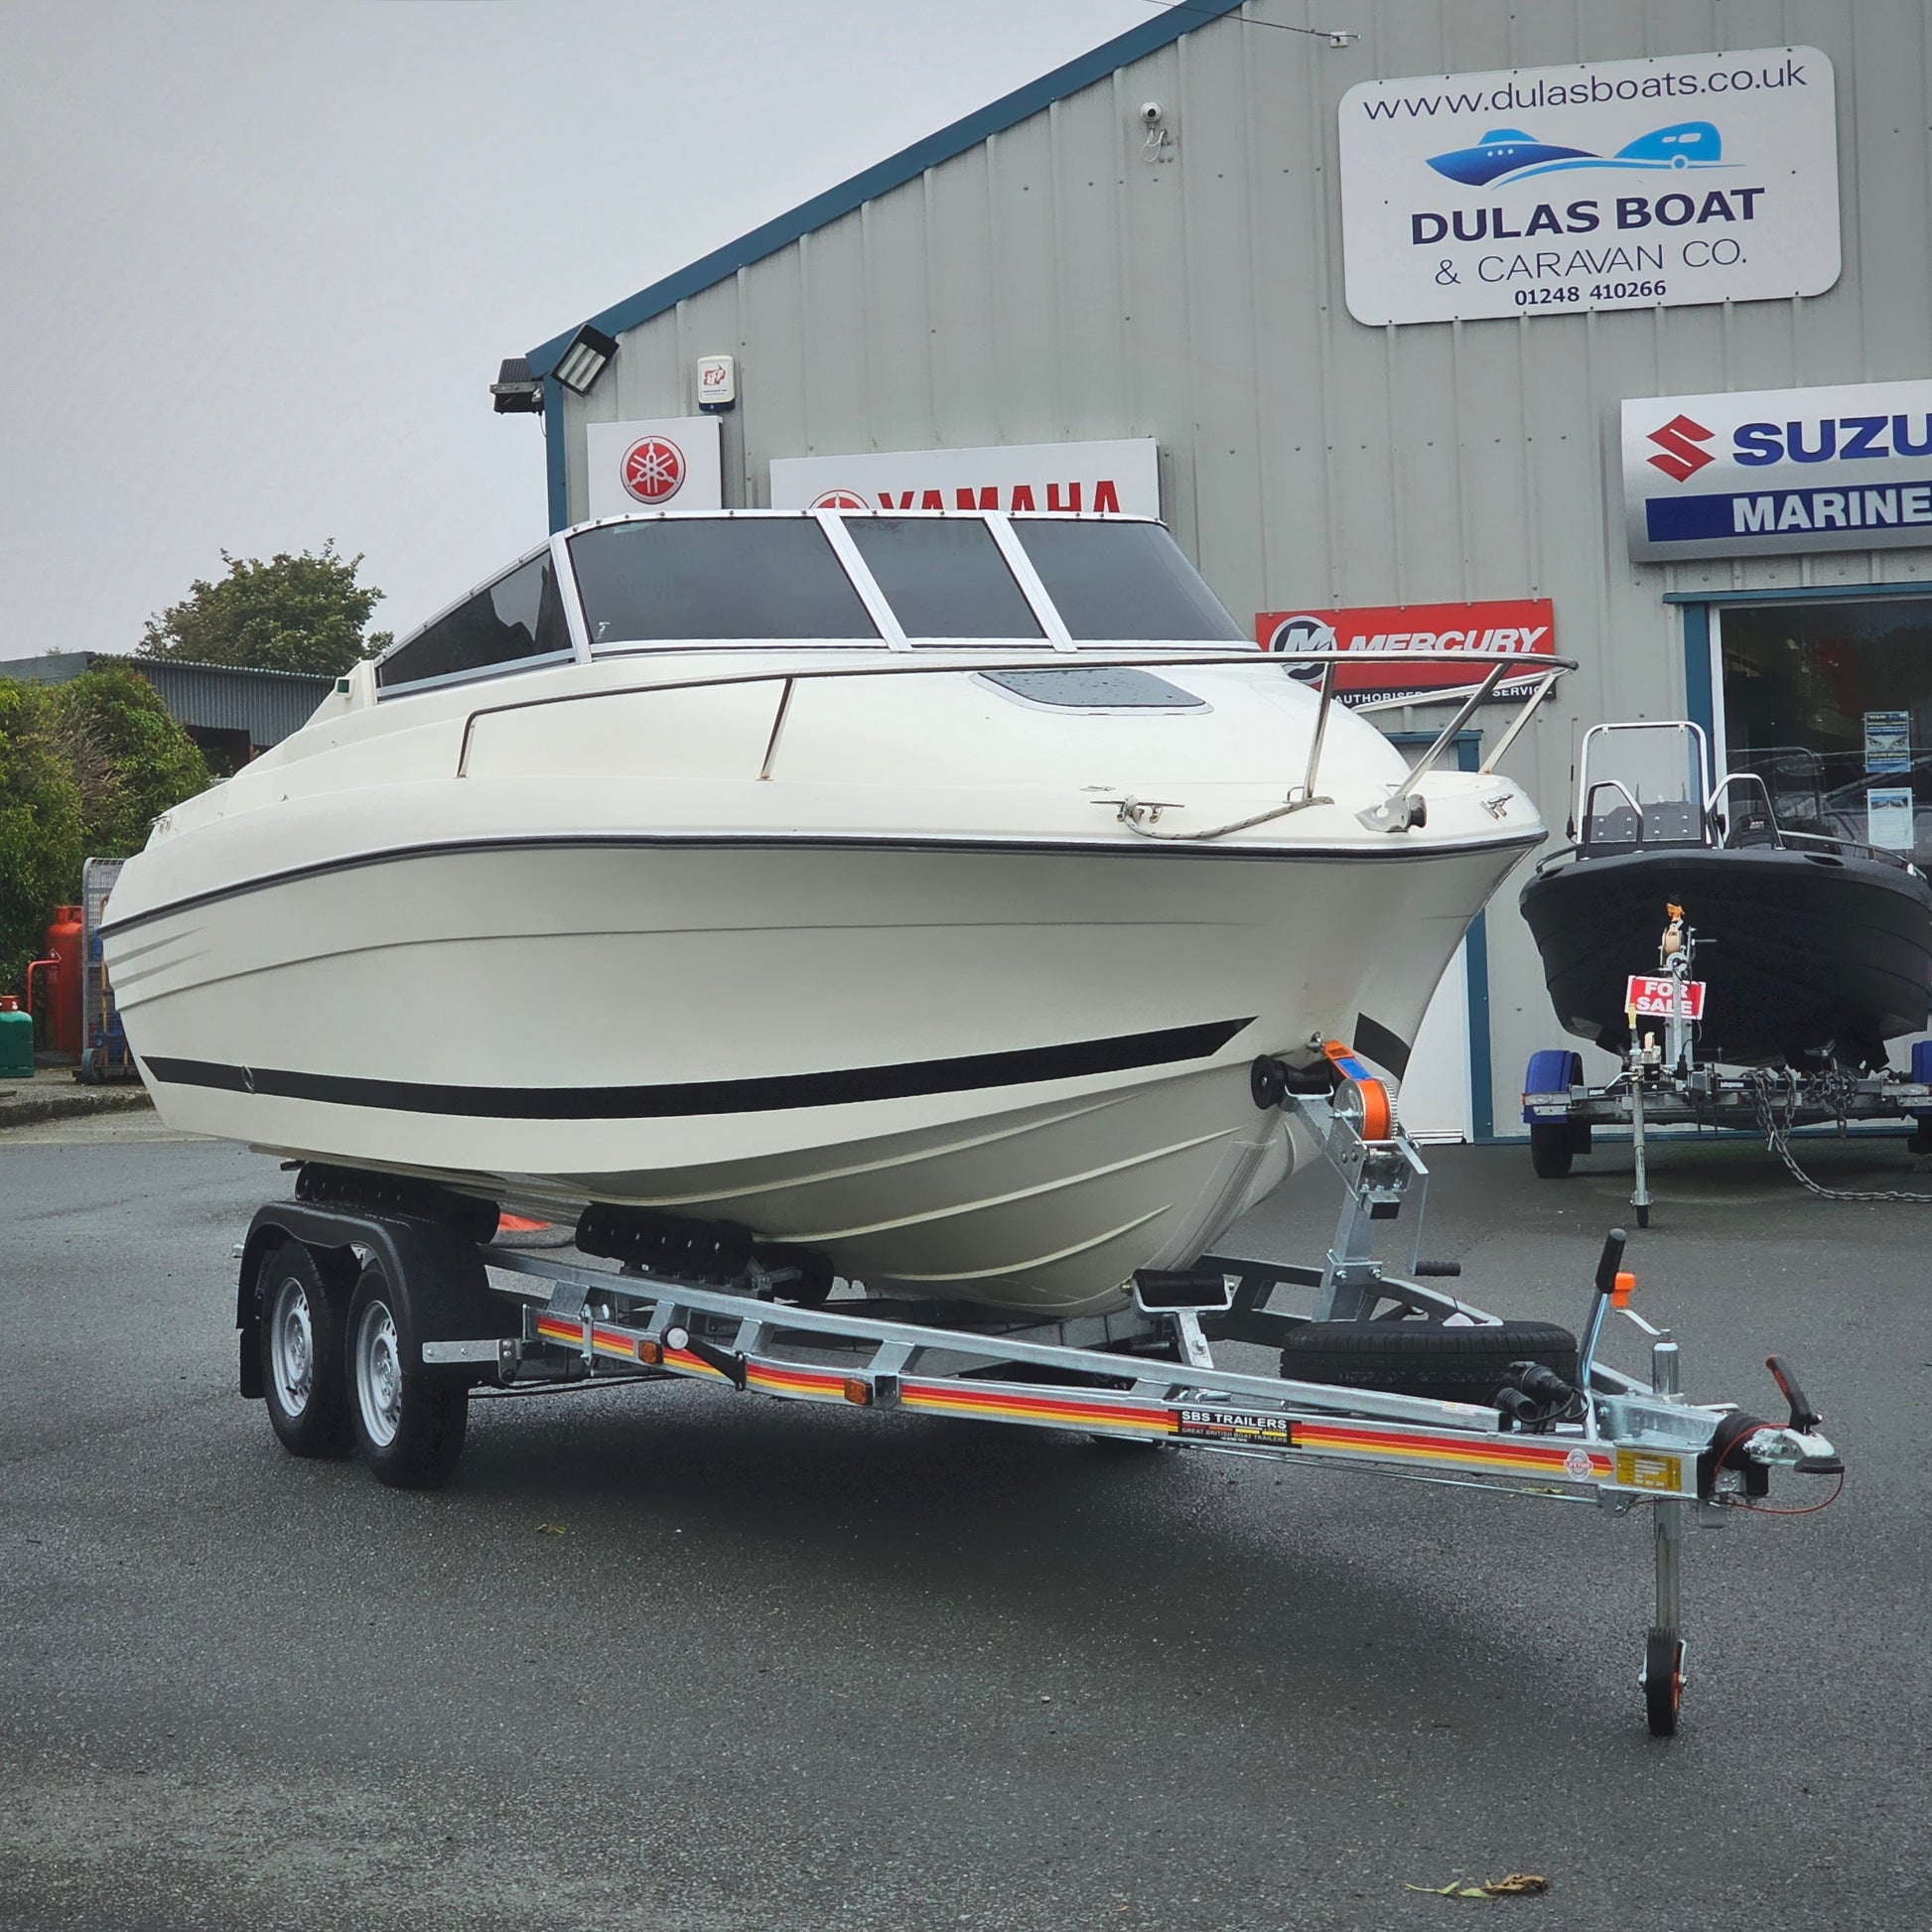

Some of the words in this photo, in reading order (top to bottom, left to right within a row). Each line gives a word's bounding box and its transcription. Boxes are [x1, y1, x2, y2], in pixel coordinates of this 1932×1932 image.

[1363, 60, 1808, 120] www.dulasboats.co.uk
[1411, 200, 1599, 245] DULAS
[1616, 187, 1765, 229] BOAT
[1435, 259, 1461, 285] &
[1477, 244, 1664, 283] CARAVAN
[1683, 238, 1747, 268] CO.
[1514, 286, 1580, 306] 01248
[1589, 280, 1667, 300] 410266
[1732, 413, 1932, 466] SUZU
[1732, 486, 1932, 533] MARINE
[1348, 626, 1549, 652] MERCURY
[1492, 685, 1553, 697] SERVIC
[1644, 981, 1689, 999] FOR
[1635, 996, 1693, 1015] SALE
[1181, 1411, 1210, 1422] SBS
[1214, 1414, 1288, 1429] TRAILERS
